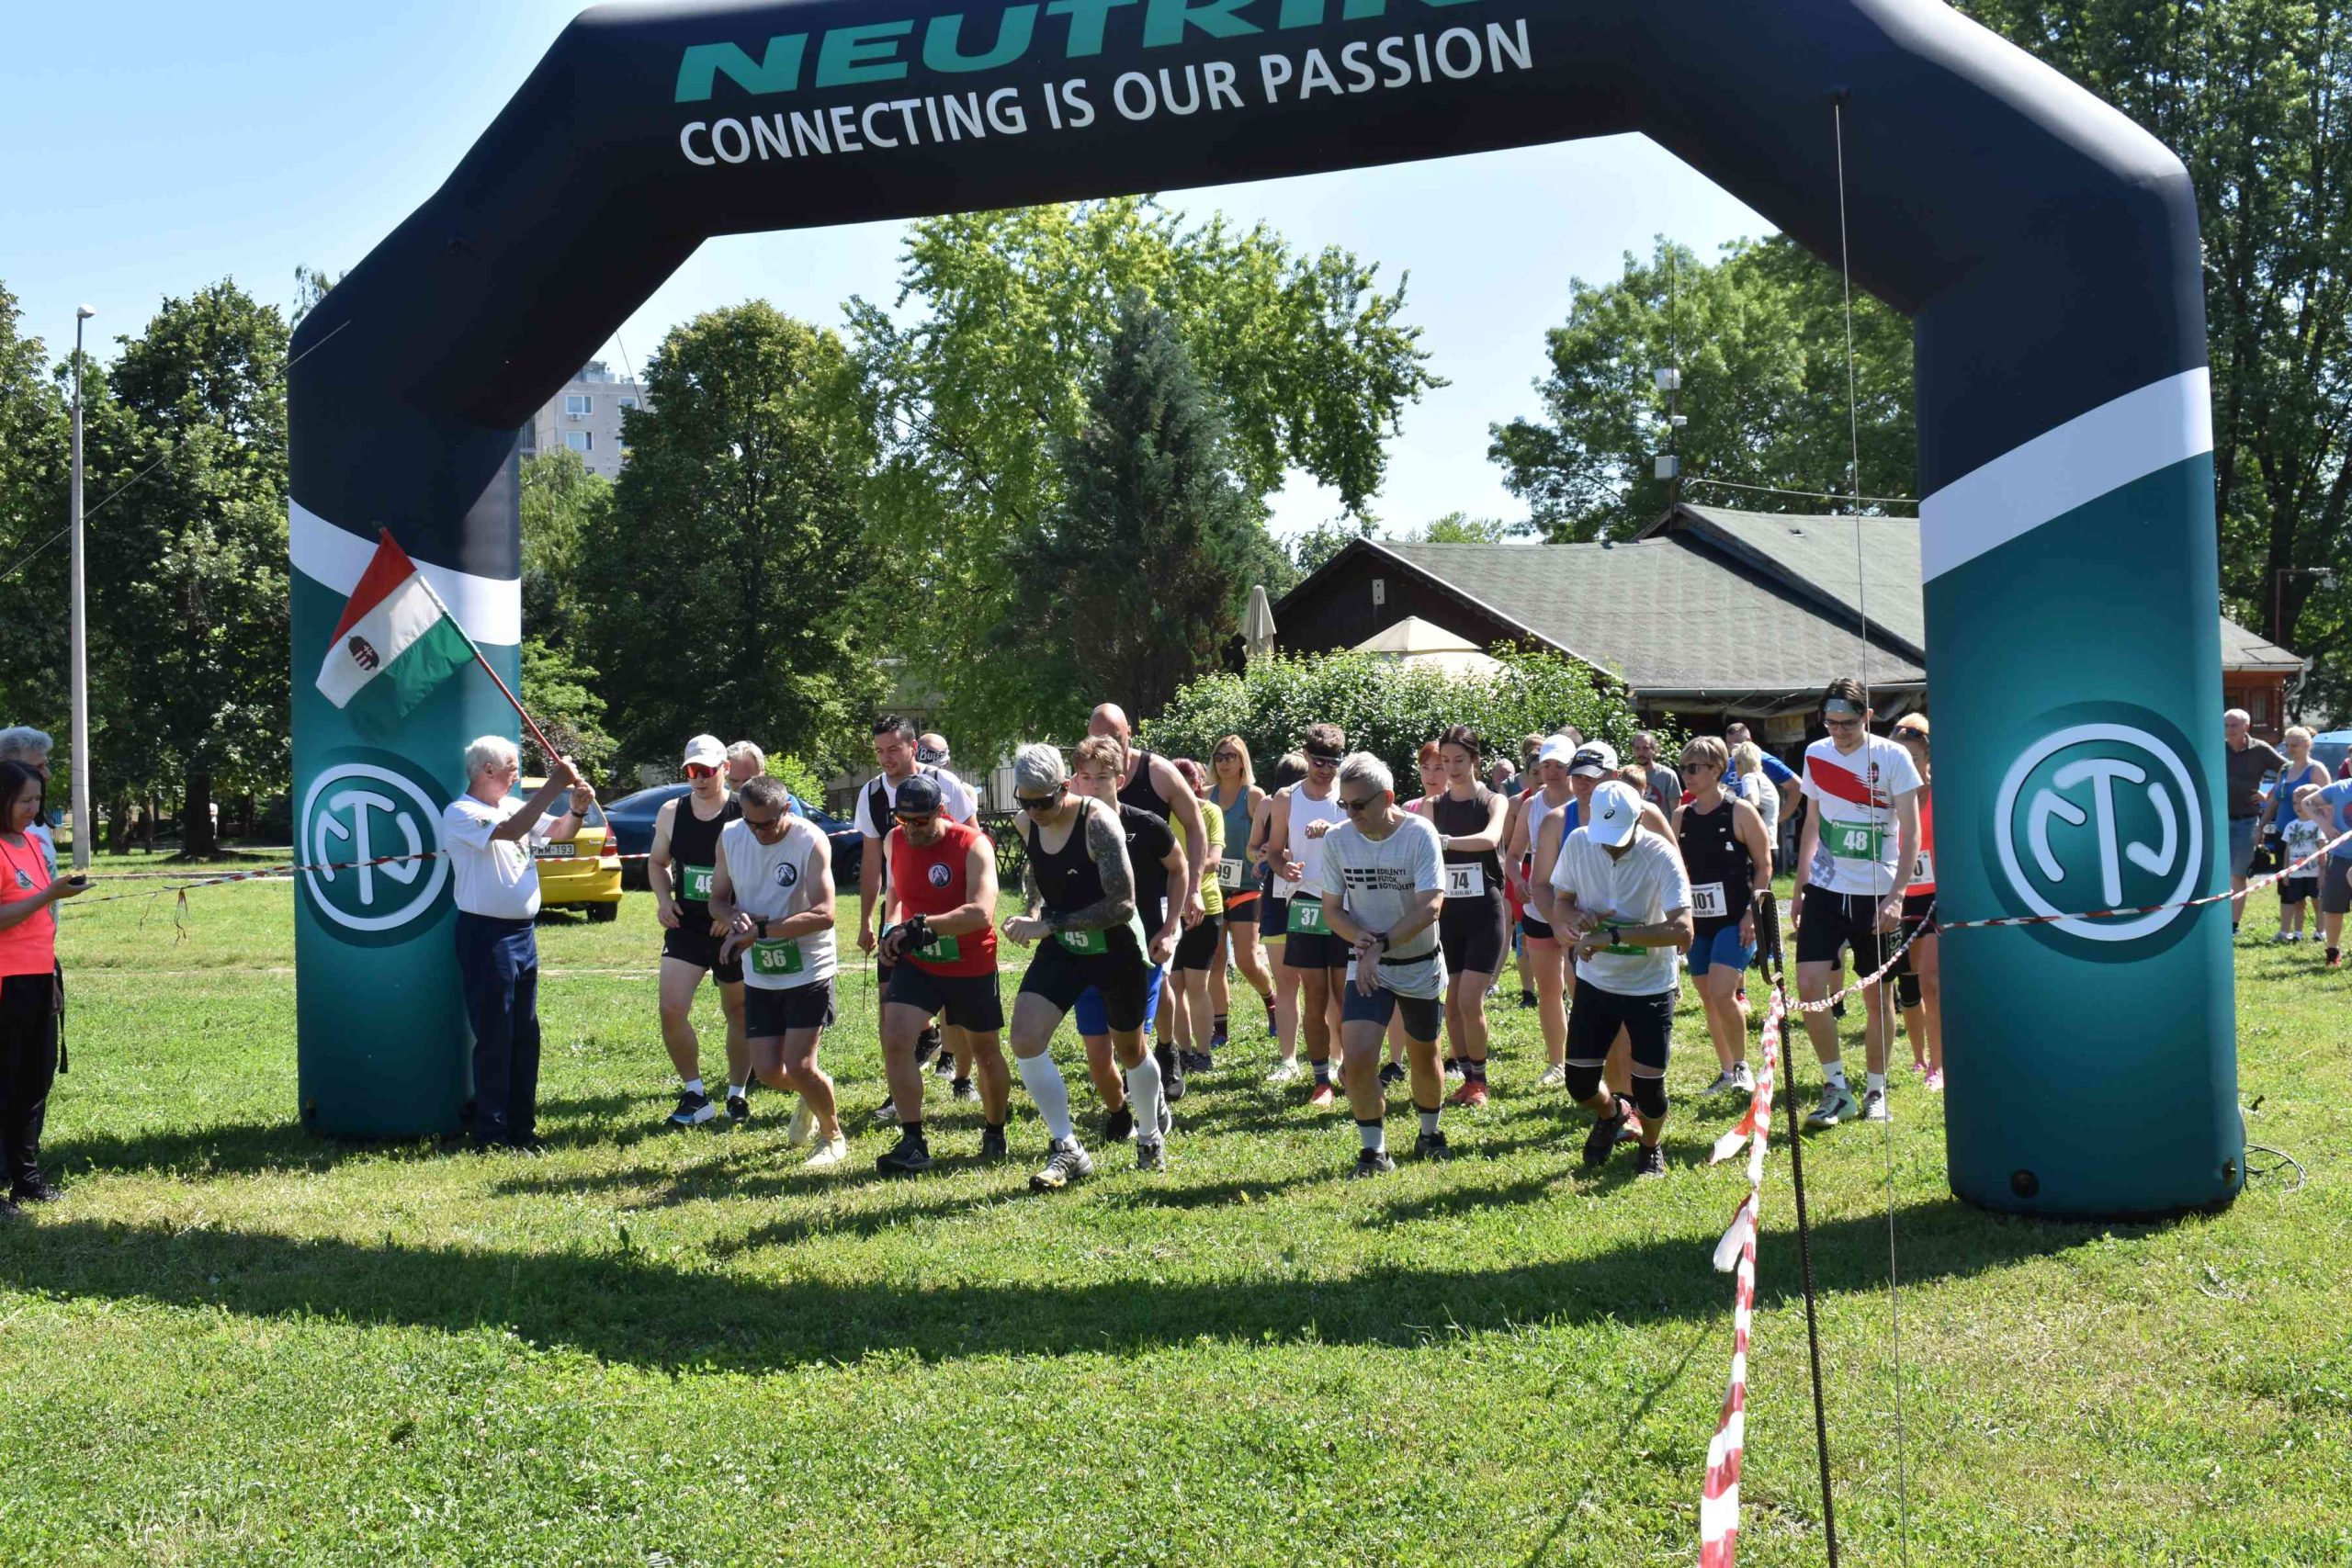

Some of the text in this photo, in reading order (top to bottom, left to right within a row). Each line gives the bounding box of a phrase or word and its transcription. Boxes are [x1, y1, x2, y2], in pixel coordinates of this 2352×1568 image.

[680, 18, 1532, 166] CONNECTING IS OUR PASSION
[1843, 830, 1868, 851] 48
[1452, 872, 1469, 889] 74
[1691, 891, 1715, 909] 101
[1301, 908, 1319, 926] 37
[1065, 931, 1089, 947] 45
[761, 949, 786, 968] 36
